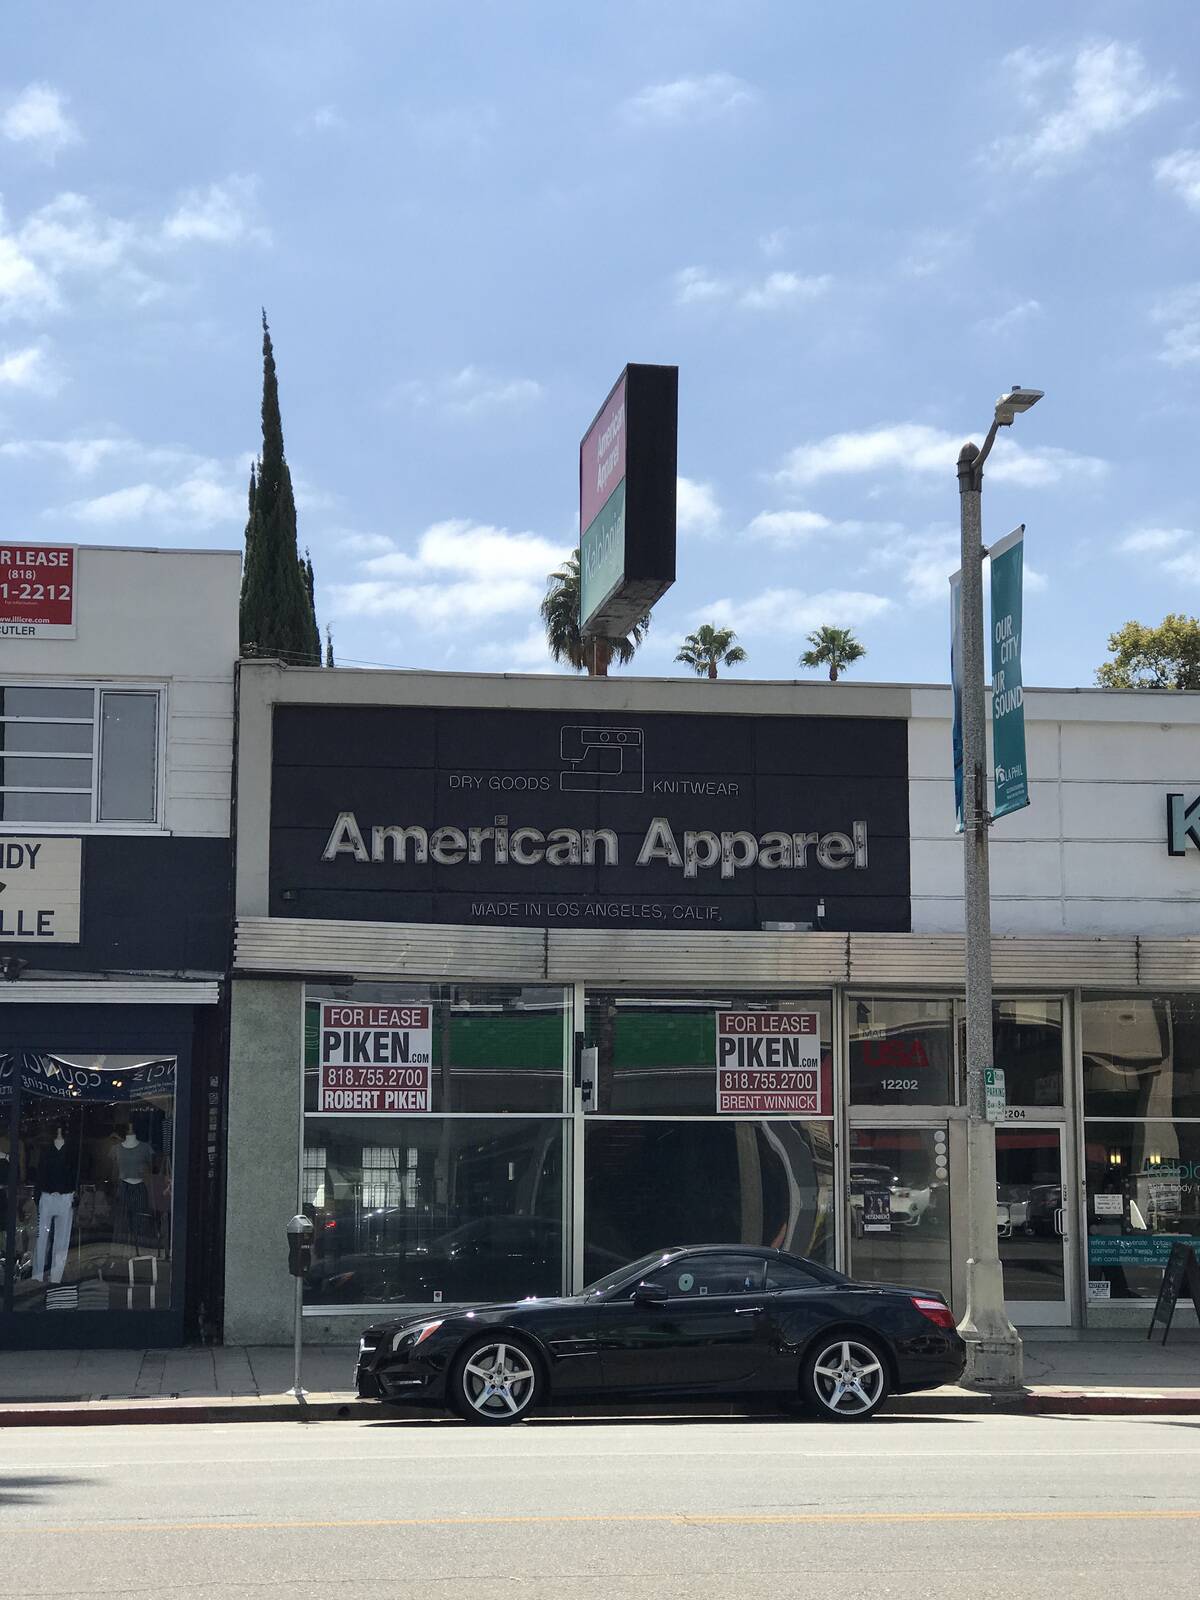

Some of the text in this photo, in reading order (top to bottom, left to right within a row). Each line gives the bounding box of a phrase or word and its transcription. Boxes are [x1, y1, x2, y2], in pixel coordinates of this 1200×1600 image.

[16, 551, 69, 567] LEASE
[8, 569, 36, 580] (818)
[0, 583, 70, 600] 1-2212
[0, 626, 36, 636] UTLER
[995, 614, 1013, 644] OUR
[1001, 634, 1020, 665] CITY
[995, 685, 1024, 719] SOUND
[449, 775, 551, 791] DRY GOODS
[653, 780, 740, 796] KNITWEAR
[320, 811, 870, 879] American Apparel
[0, 843, 42, 870] DY
[471, 902, 520, 917] MADE
[525, 902, 541, 917] IN
[547, 902, 580, 918] LOS
[585, 903, 667, 920] ANGELES,
[331, 1009, 422, 1026] FOR LEASE
[726, 1016, 810, 1032] FOR LEASE
[328, 1068, 423, 1086] 818.755.2700
[725, 1072, 813, 1089] 818.755.2700
[881, 1079, 919, 1090] 12202
[324, 1090, 426, 1110] ROBERT PIKEN
[722, 1096, 816, 1109] BRENT WINNICK
[1004, 1110, 1026, 1118] 204
